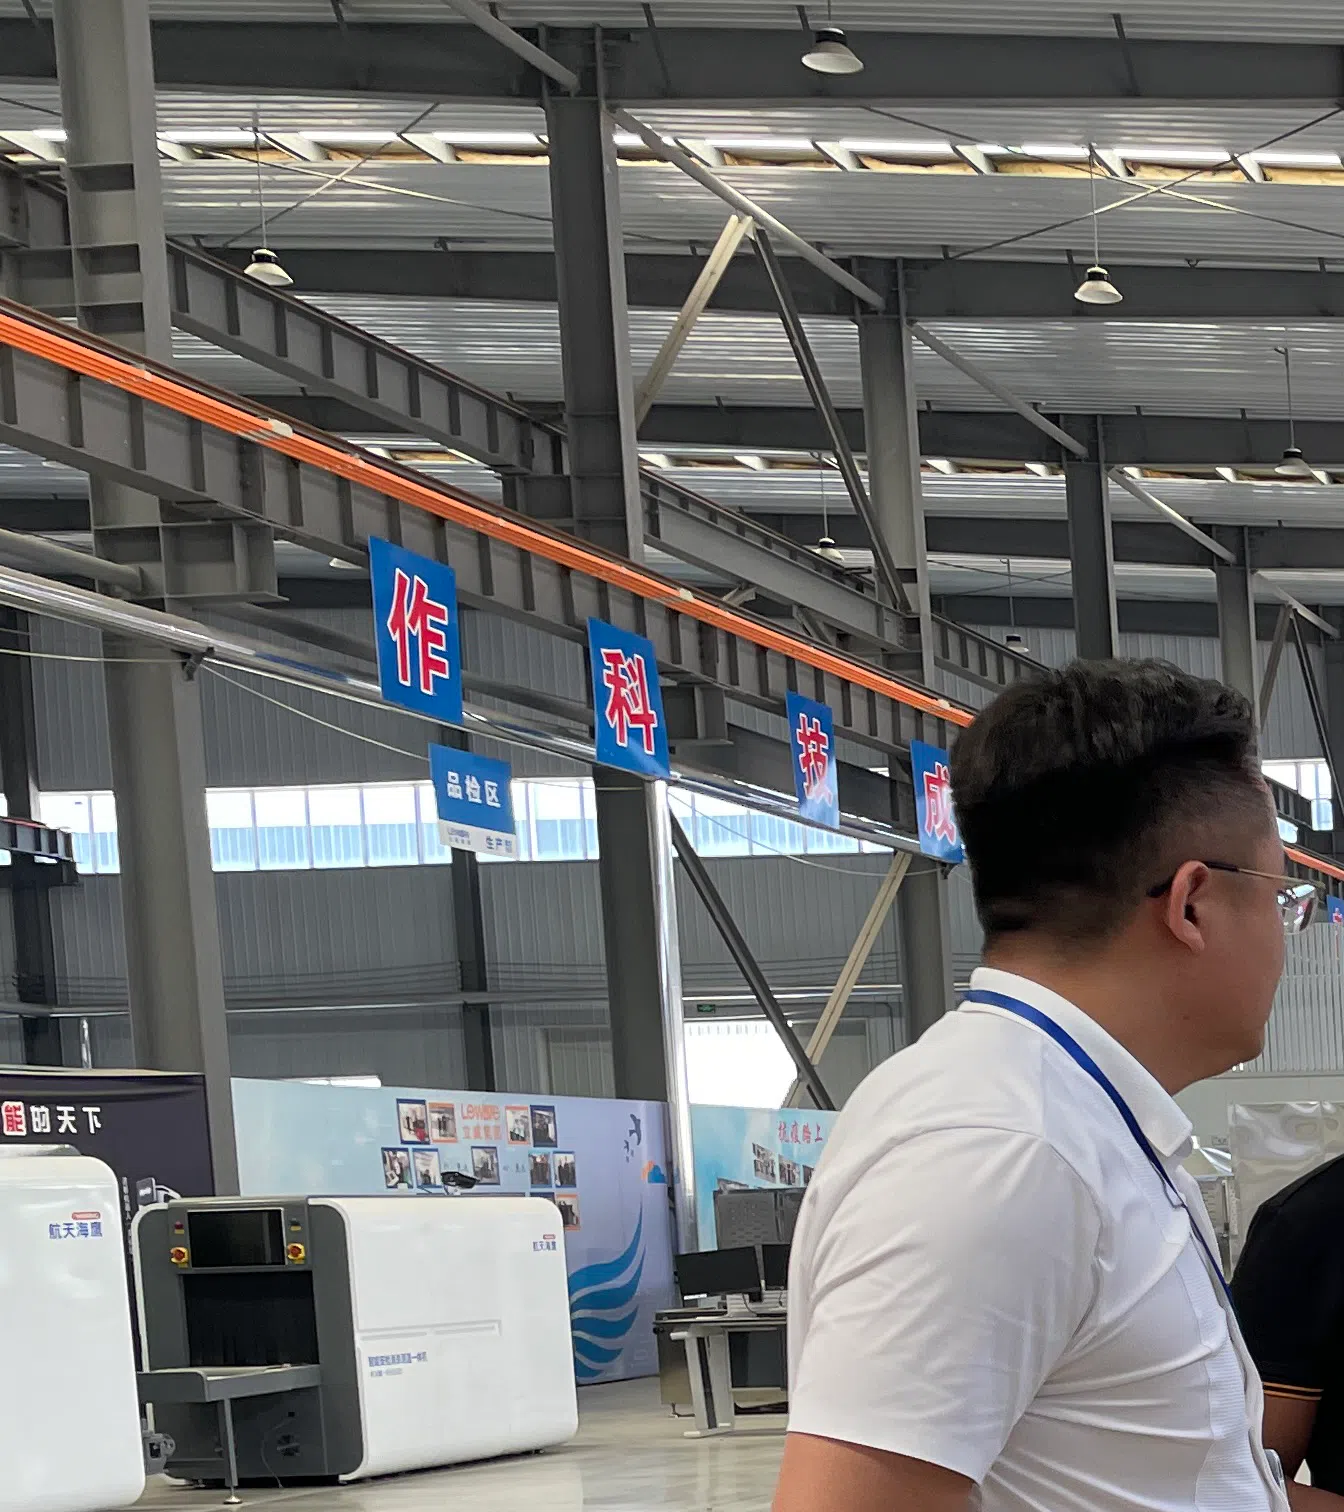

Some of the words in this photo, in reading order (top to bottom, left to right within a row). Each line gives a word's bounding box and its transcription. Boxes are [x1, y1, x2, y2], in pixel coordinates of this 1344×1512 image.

[386, 567, 450, 697] 作
[601, 647, 658, 756] 科
[796, 712, 833, 807] 技
